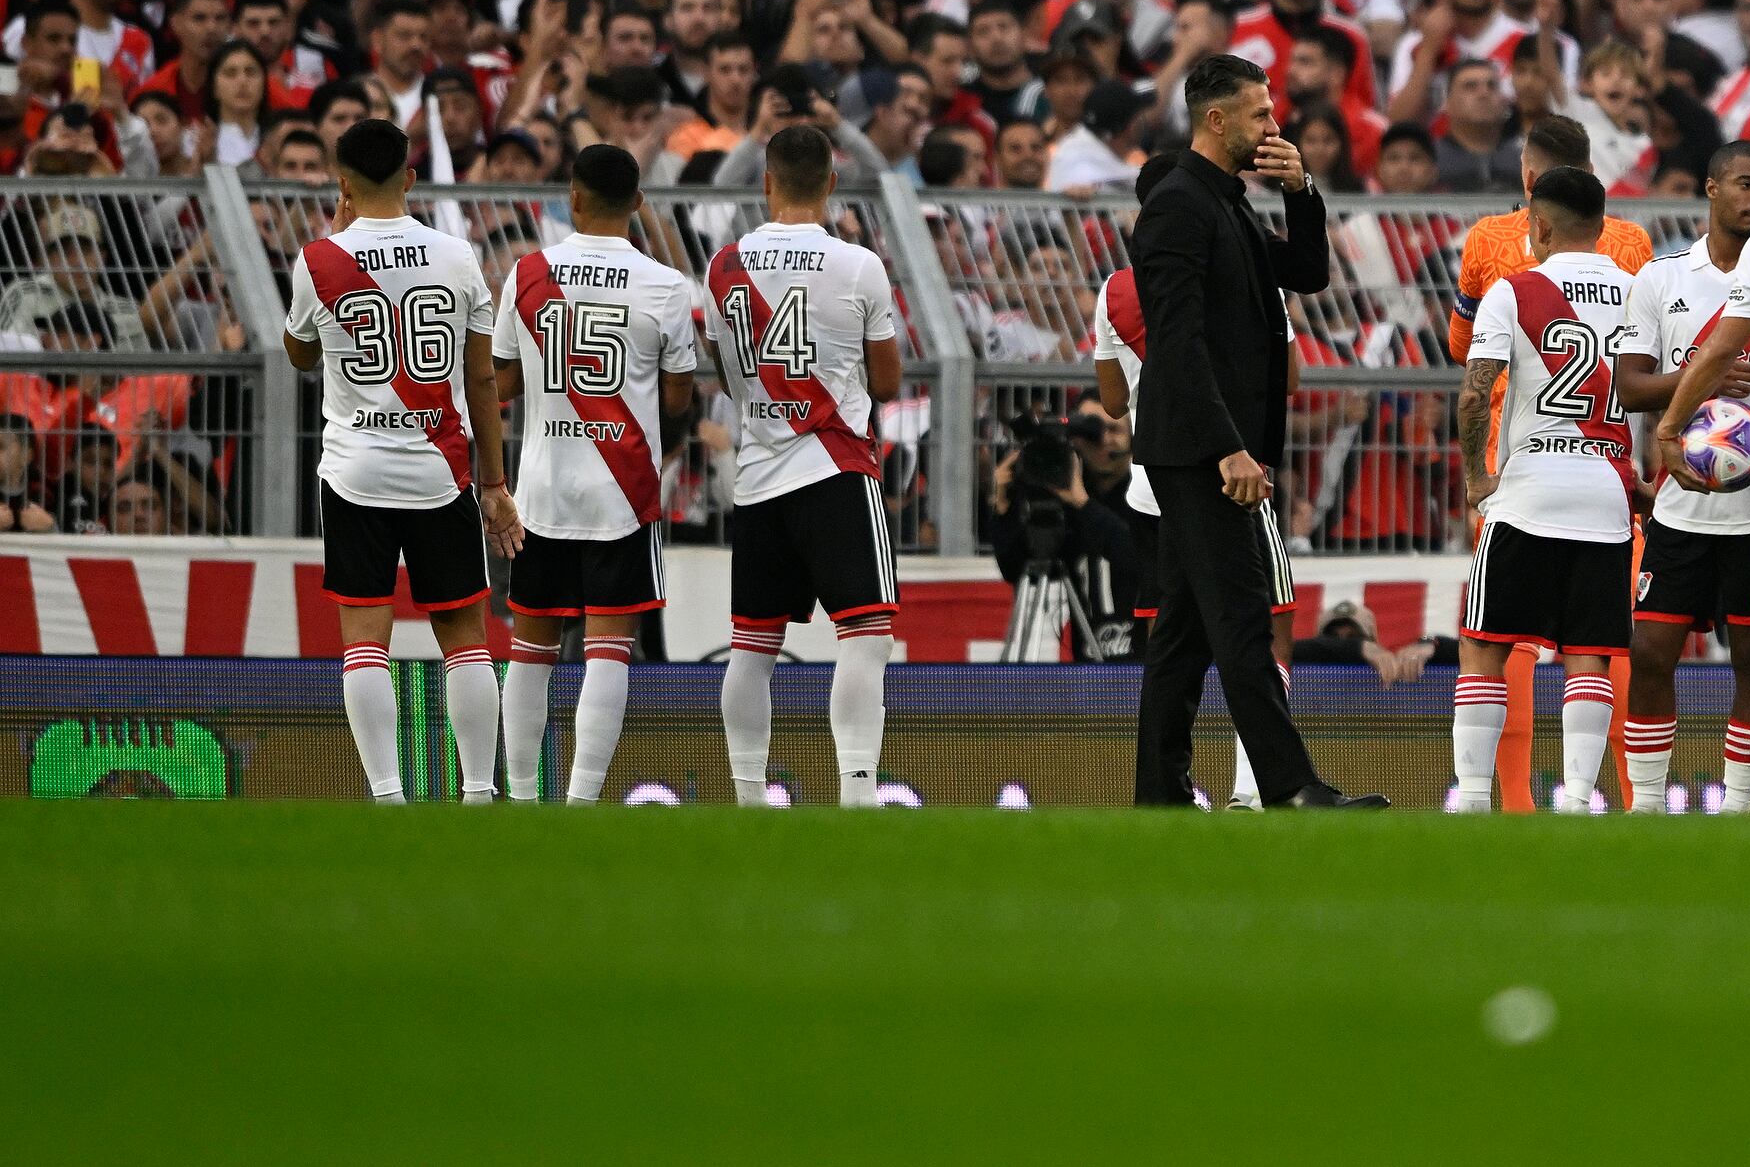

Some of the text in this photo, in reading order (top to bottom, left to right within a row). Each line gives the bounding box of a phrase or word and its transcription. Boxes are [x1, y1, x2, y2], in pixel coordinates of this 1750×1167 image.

[355, 245, 430, 273] SOLARI
[783, 250, 825, 272] PIREZ
[549, 264, 630, 289] HERRERA
[1562, 281, 1622, 306] BARCO
[334, 284, 456, 386] 36
[722, 284, 818, 381] 14
[536, 299, 630, 397] 15
[1536, 318, 1626, 426] 21
[352, 409, 442, 430] DIRECTV
[751, 401, 812, 420] IRECTV
[1529, 438, 1626, 458] DIRECTV
